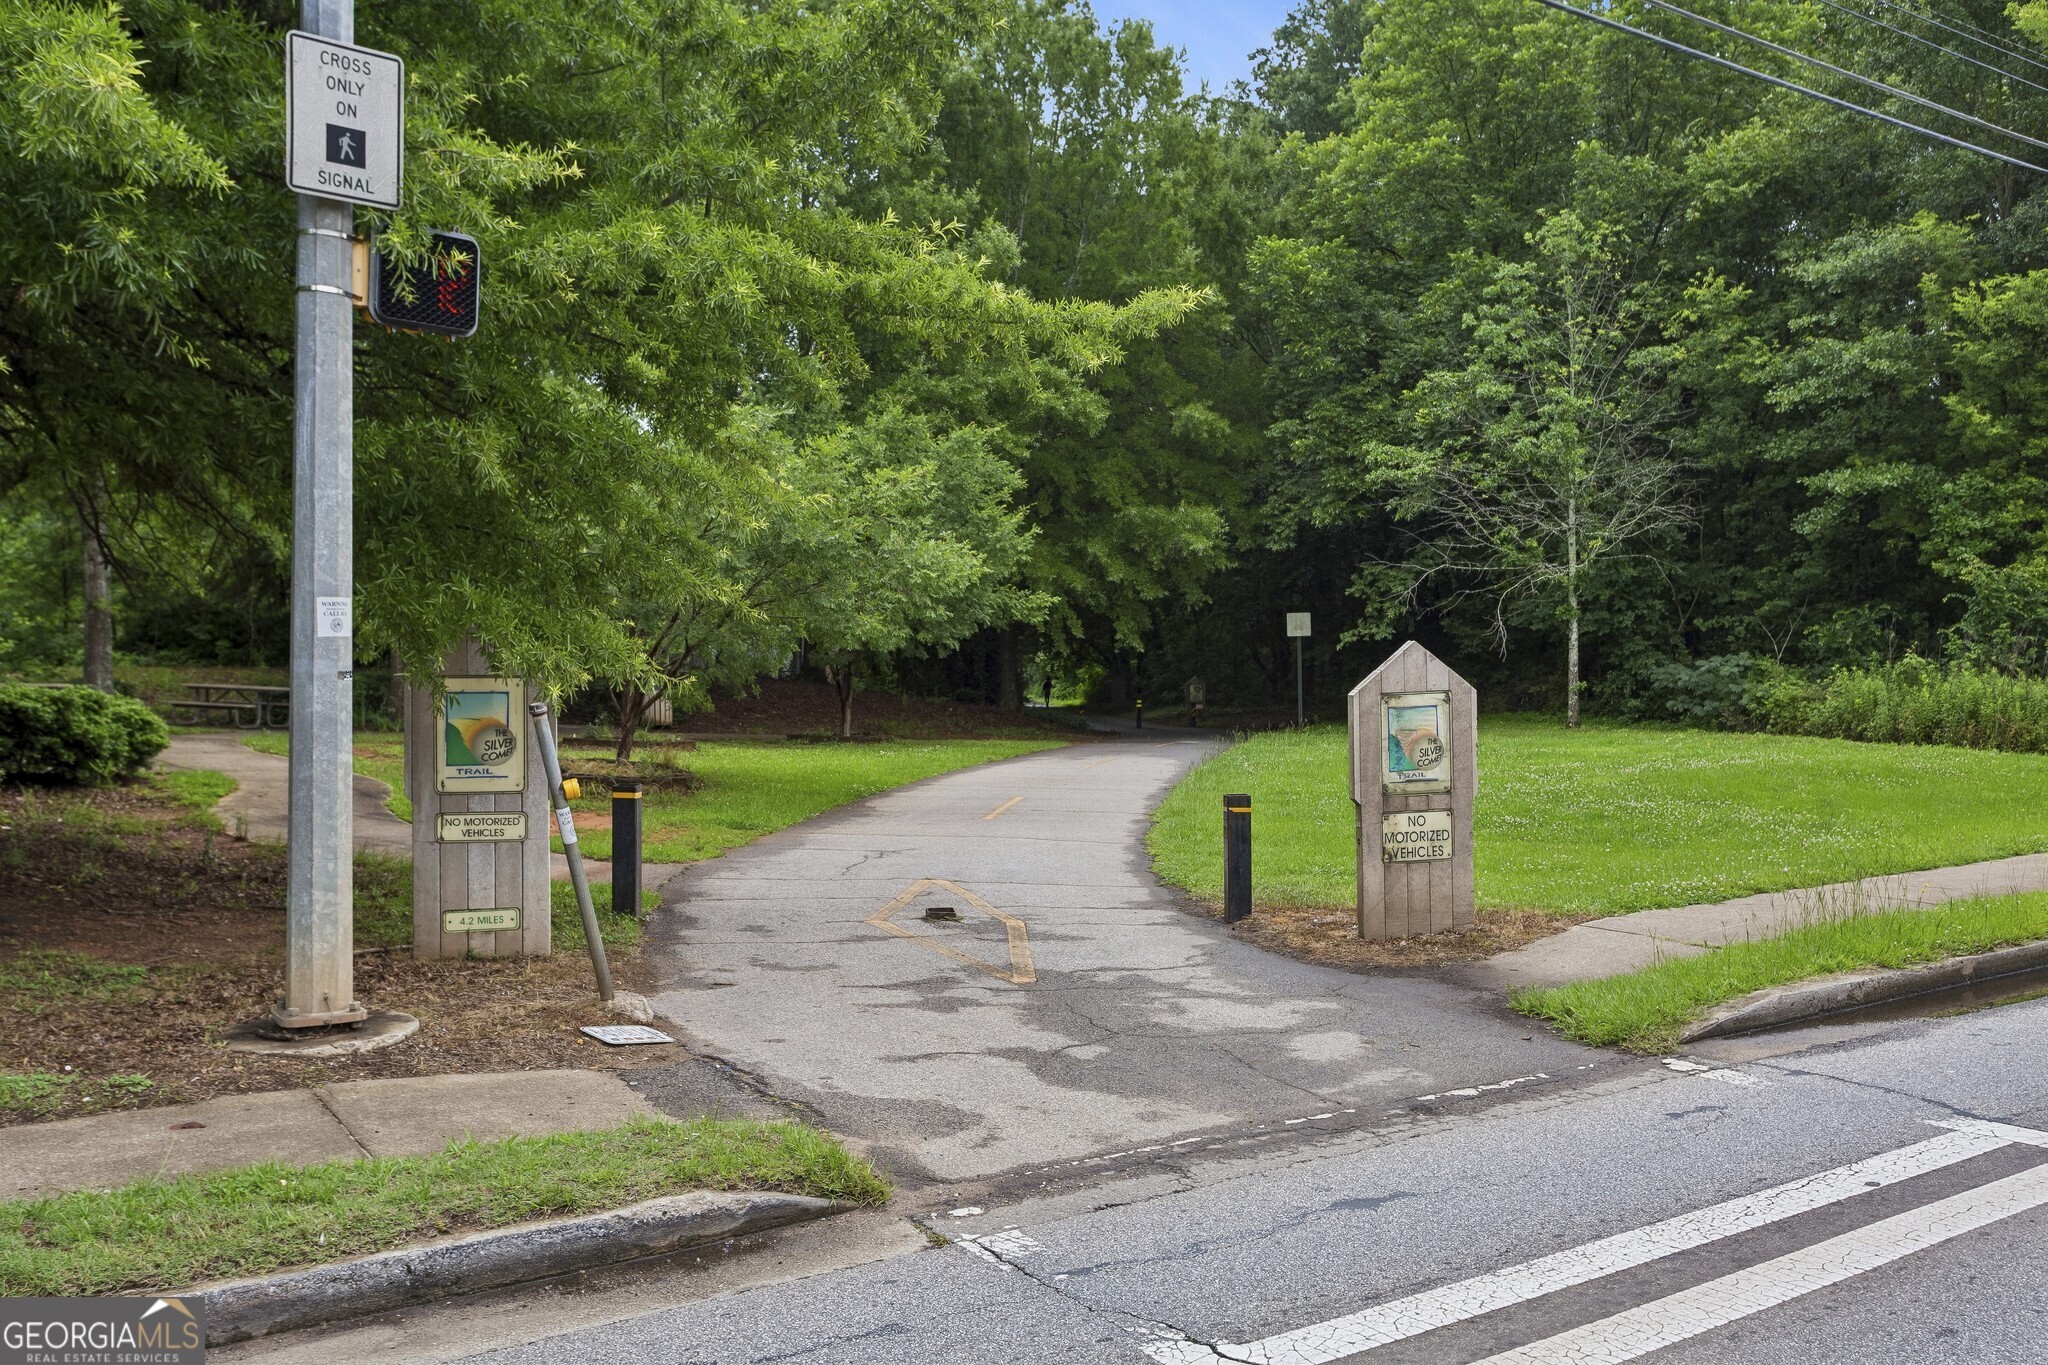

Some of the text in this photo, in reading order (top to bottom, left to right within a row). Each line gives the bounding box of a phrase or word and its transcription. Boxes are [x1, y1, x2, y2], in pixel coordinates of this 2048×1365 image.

[320, 51, 371, 75] CROSS
[326, 76, 365, 97] ONLY
[336, 101, 357, 118] ON
[318, 170, 374, 194] SIGNAL
[495, 729, 508, 738] THE
[484, 738, 513, 752] SILVER
[1419, 745, 1442, 758] SILVER
[481, 747, 513, 762] COMET
[1417, 754, 1442, 767] COMET
[445, 817, 520, 827] NO MOTORIZED
[1407, 815, 1426, 827] NO
[461, 829, 505, 837] VEHICLES
[1384, 829, 1450, 844] MOTORIZED
[1391, 845, 1444, 859] VEHICLES
[459, 915, 504, 925] 4.2 MILES
